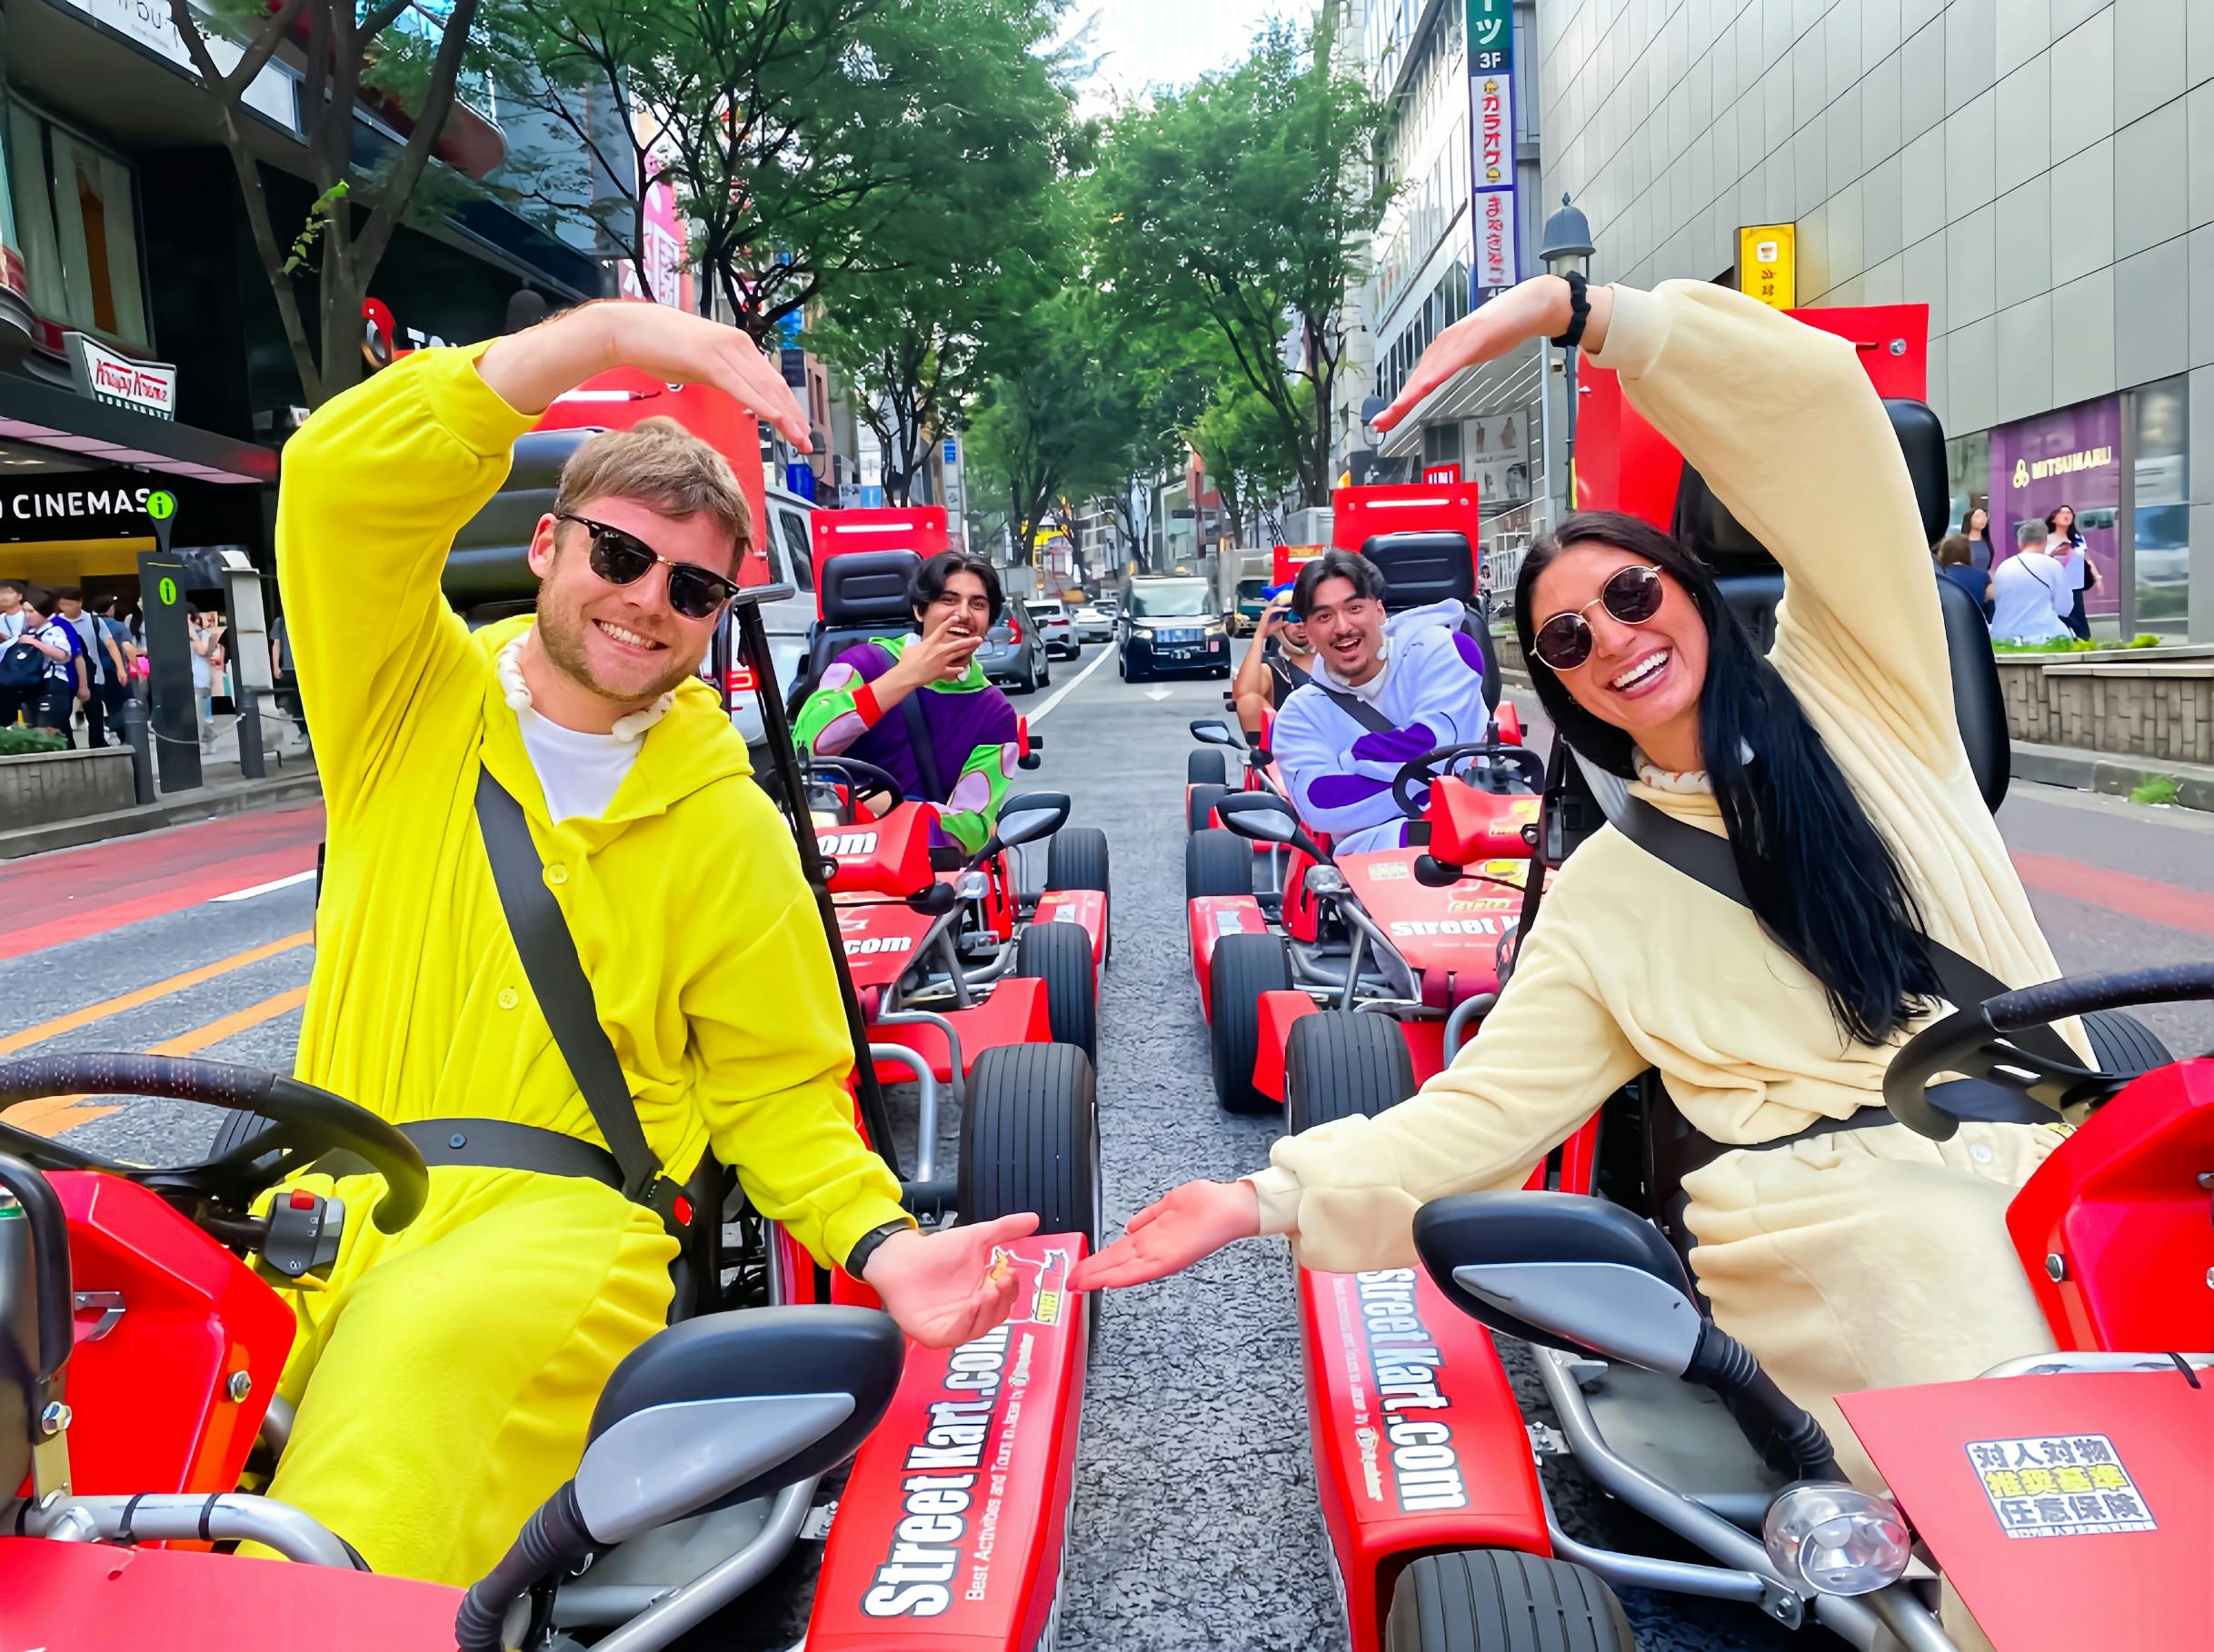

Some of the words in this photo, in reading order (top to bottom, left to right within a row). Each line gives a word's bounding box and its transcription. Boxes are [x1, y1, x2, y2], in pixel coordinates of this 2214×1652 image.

[1480, 52, 1501, 69] 3F
[95, 358, 133, 397] Krispy
[13, 488, 151, 520] CINEMAS
[1972, 1439, 2112, 1468] 対人対物
[2000, 1493, 2144, 1526] 任意保険
[964, 1565, 990, 1601] Best
